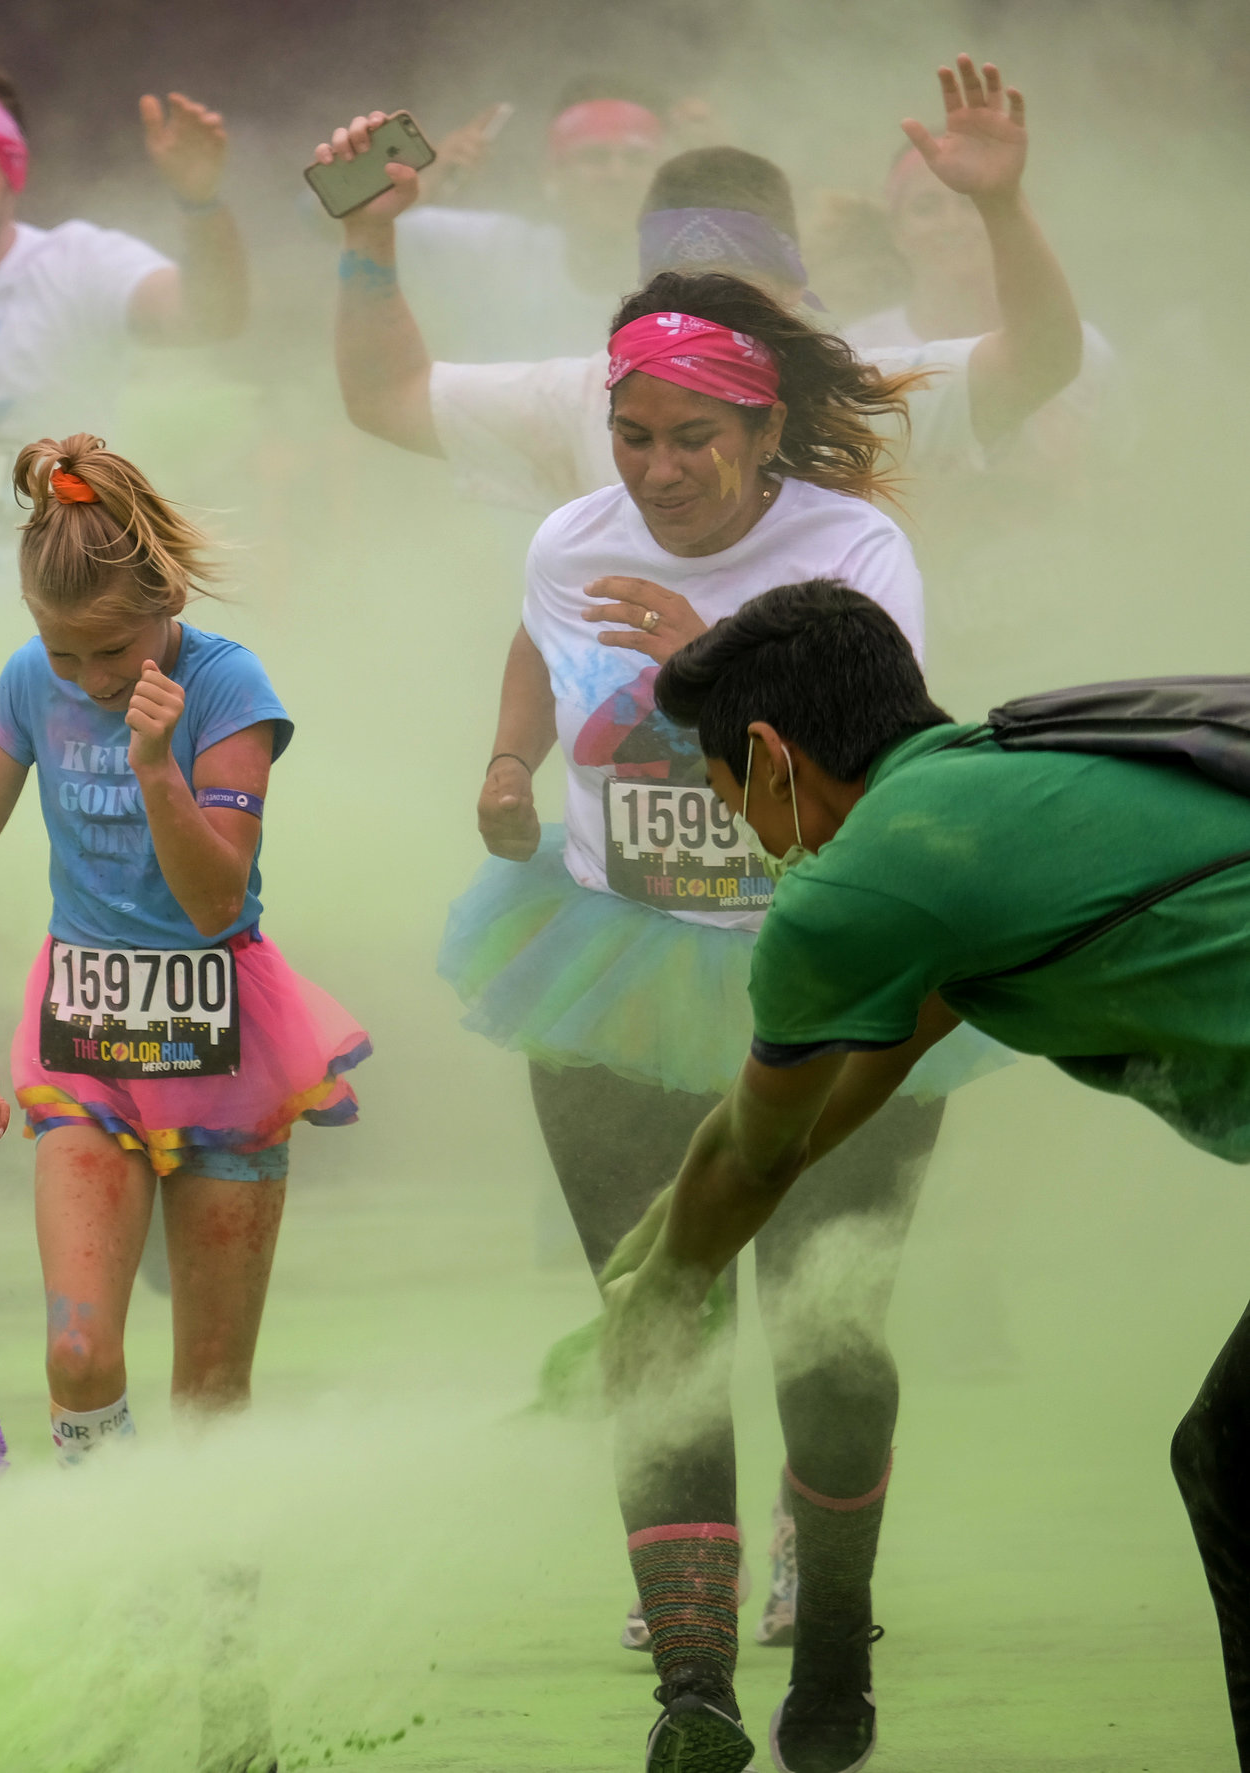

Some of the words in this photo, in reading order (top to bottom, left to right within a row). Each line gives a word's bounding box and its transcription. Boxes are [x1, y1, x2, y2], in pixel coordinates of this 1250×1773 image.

[59, 740, 134, 775] KEE
[645, 875, 674, 897] THE
[739, 877, 772, 898] RUN
[719, 898, 749, 907] HERO
[62, 950, 225, 1012] 159700
[72, 1038, 99, 1060] THE
[100, 1040, 160, 1062] COLOR
[161, 1042, 194, 1060] RUN
[142, 1061, 171, 1072] HERO
[173, 1060, 201, 1070] TOUR
